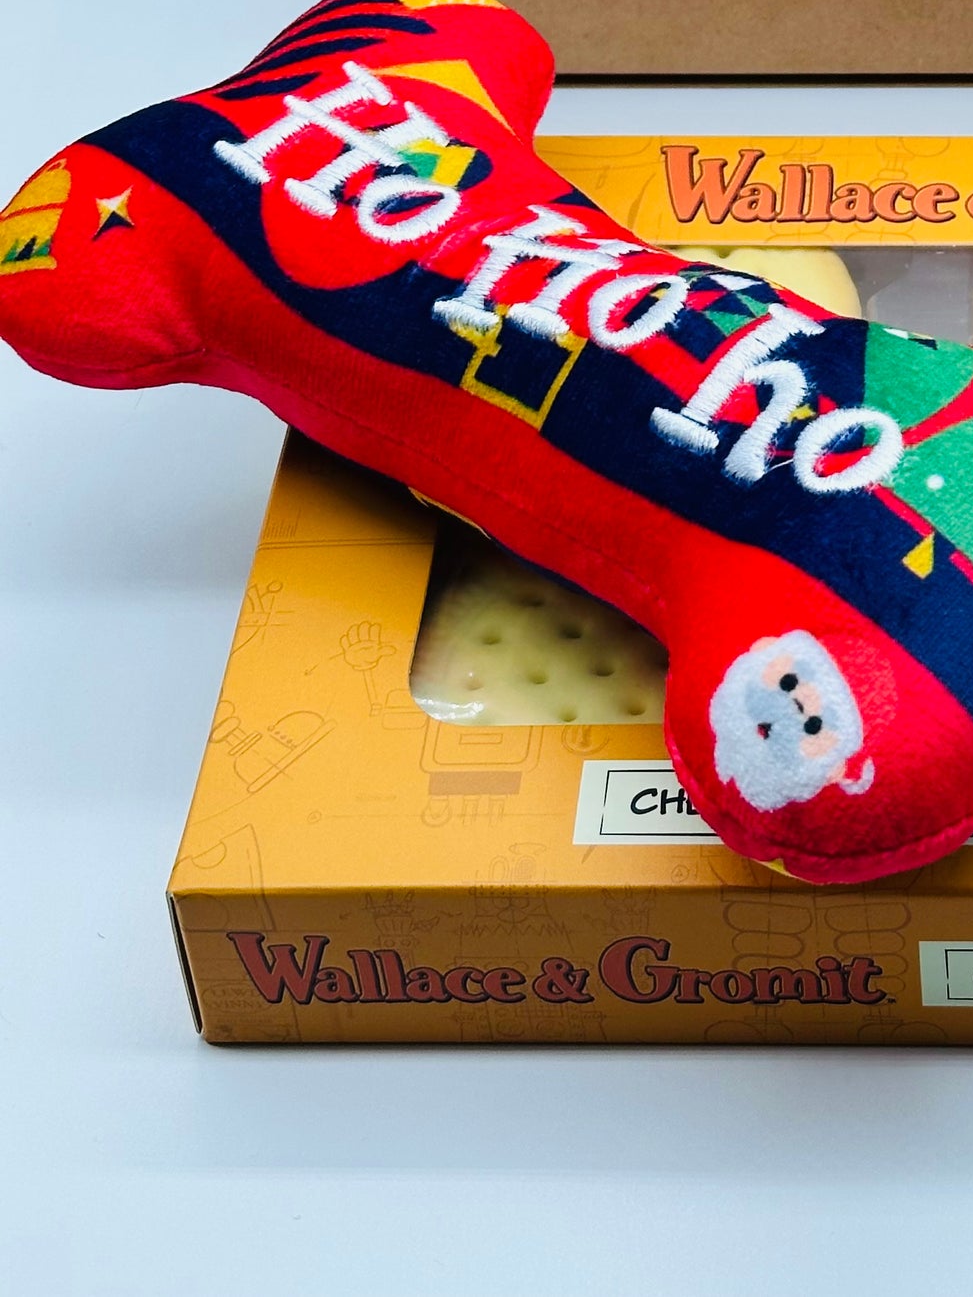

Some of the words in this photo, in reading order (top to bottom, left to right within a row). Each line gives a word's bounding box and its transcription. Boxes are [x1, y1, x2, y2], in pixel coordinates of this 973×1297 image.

[661, 145, 960, 224] Wallace
[214, 61, 459, 244] Ho
[432, 203, 691, 350] Ho
[650, 303, 903, 494] ho
[227, 931, 528, 1004] Wallace
[532, 957, 595, 1003] &
[599, 936, 888, 1004] Gromit
